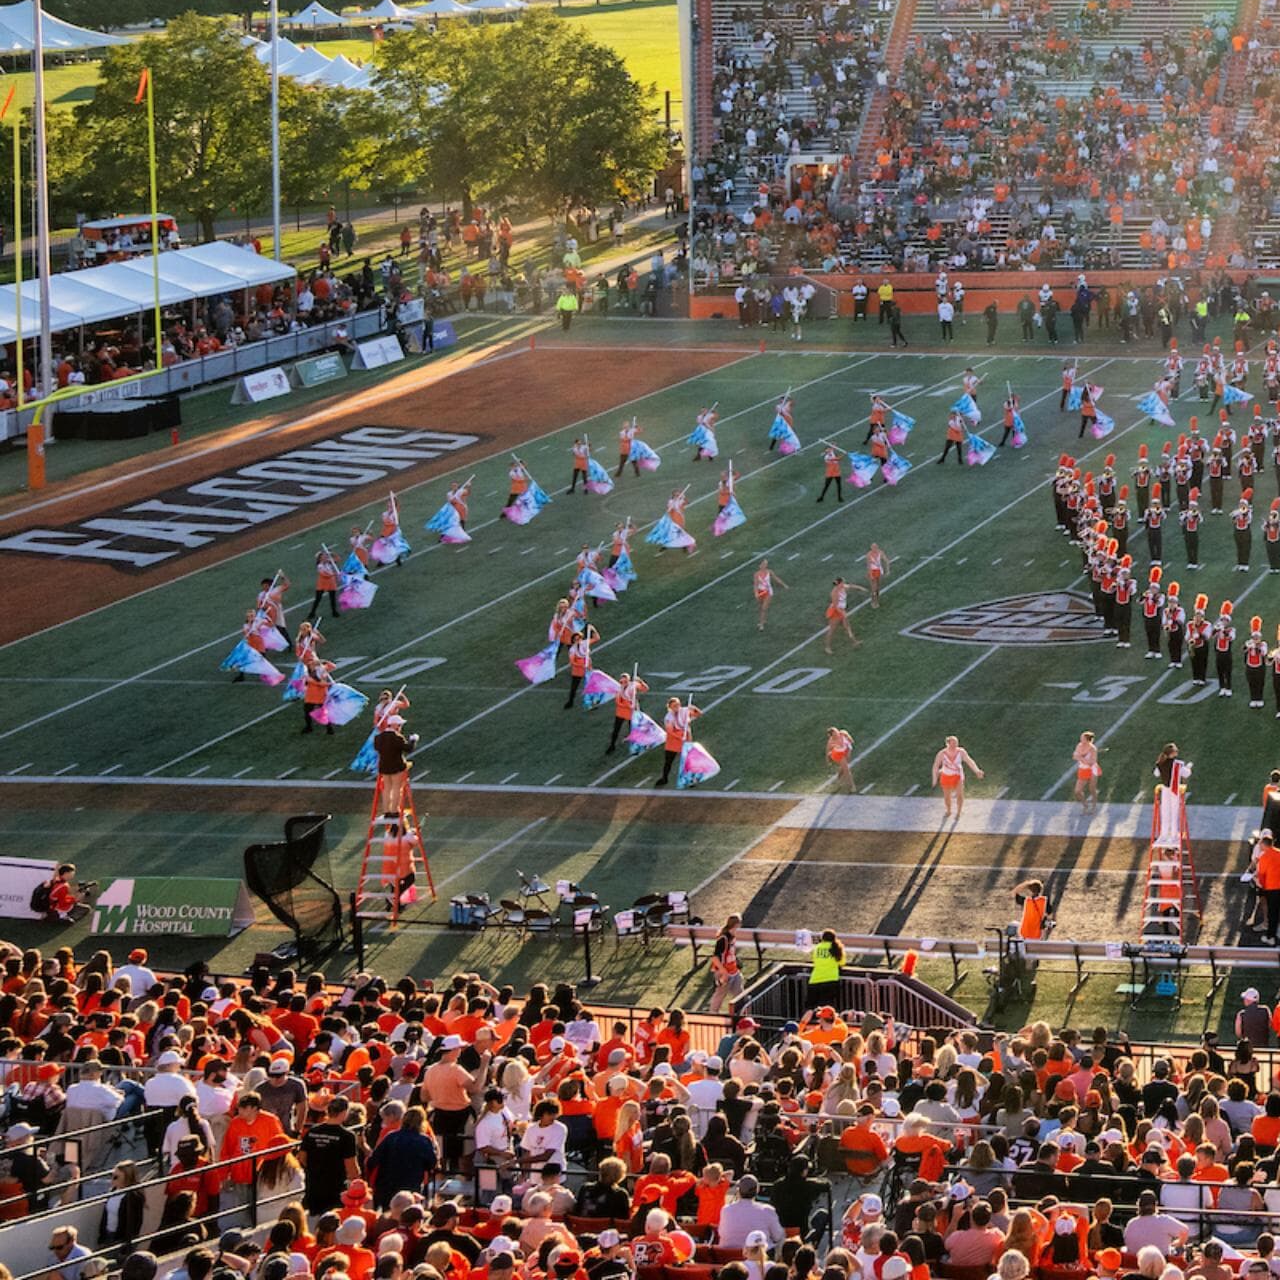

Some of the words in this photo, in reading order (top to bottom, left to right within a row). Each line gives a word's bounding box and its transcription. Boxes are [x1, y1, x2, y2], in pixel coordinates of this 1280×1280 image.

[0, 427, 479, 567] FALCONS
[136, 904, 177, 920] WOOD
[178, 905, 235, 920] COUNTY
[132, 920, 196, 934] HOSPITAL
[1009, 1144, 1034, 1164] 27
